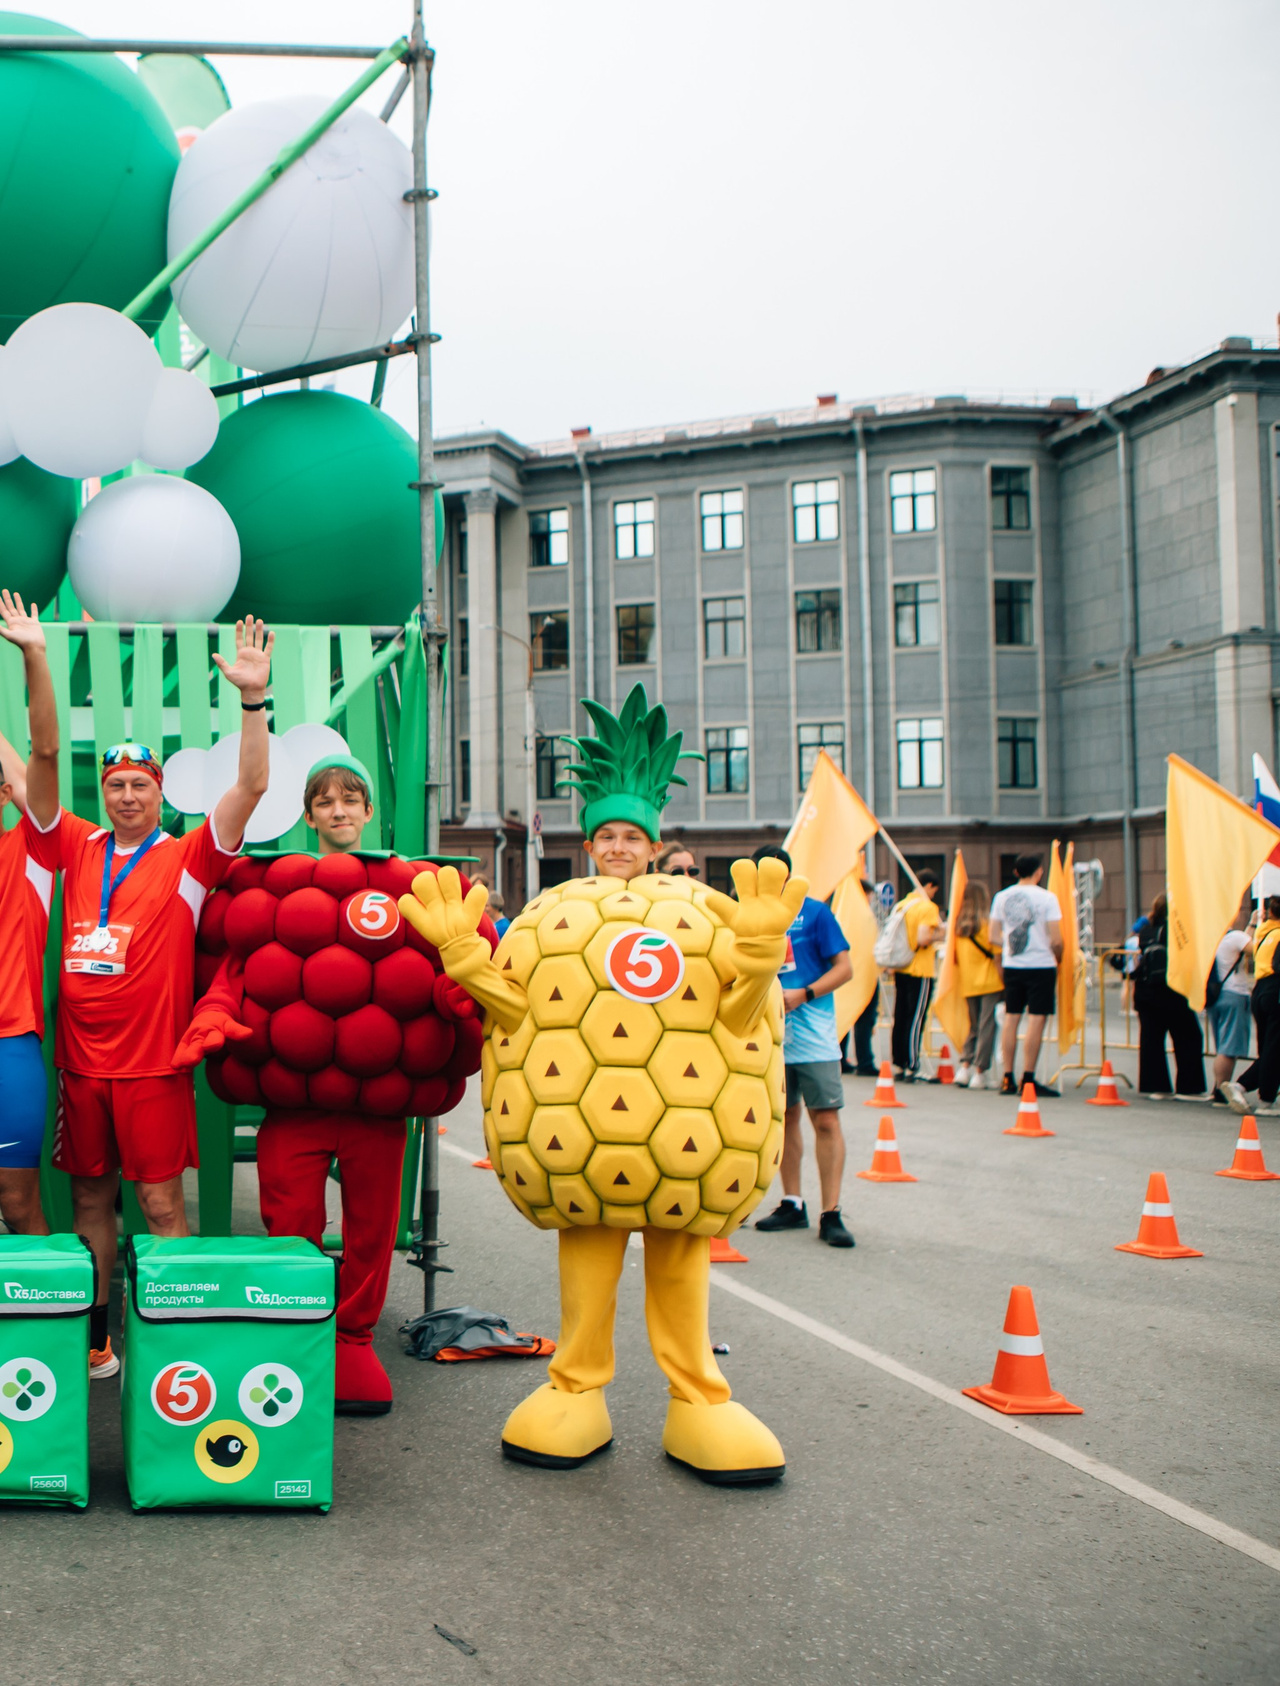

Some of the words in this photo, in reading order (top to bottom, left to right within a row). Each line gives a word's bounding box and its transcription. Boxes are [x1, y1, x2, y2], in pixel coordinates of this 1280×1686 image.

[360, 892, 390, 930] 5
[625, 932, 670, 988] 5
[145, 1281, 220, 1293] Доставляем
[145, 1294, 204, 1306] продукты
[280, 1484, 307, 1494] 25142
